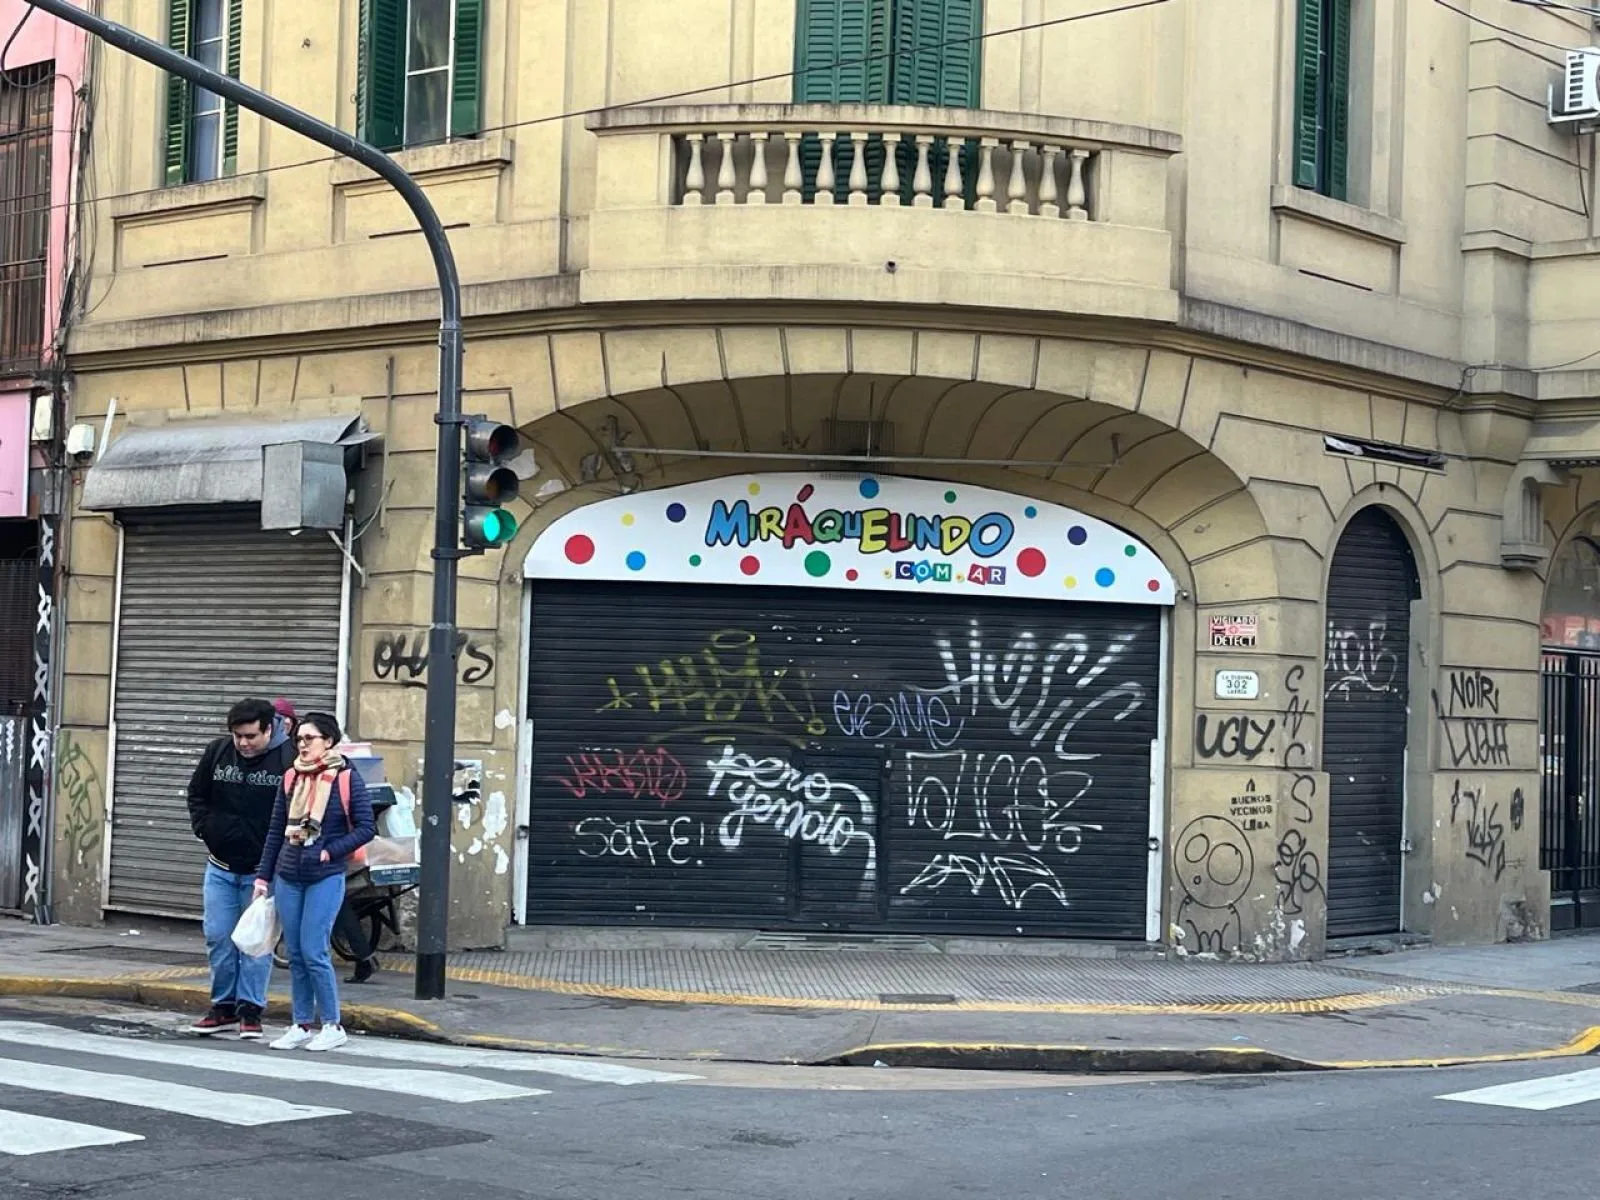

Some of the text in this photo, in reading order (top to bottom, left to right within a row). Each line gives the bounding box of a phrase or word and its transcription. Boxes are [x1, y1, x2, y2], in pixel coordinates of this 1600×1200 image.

[1212, 615, 1256, 625] VIGILADO
[1213, 635, 1255, 647] DETECT
[1226, 679, 1248, 689] 302
[1230, 805, 1273, 816] VECINOS
